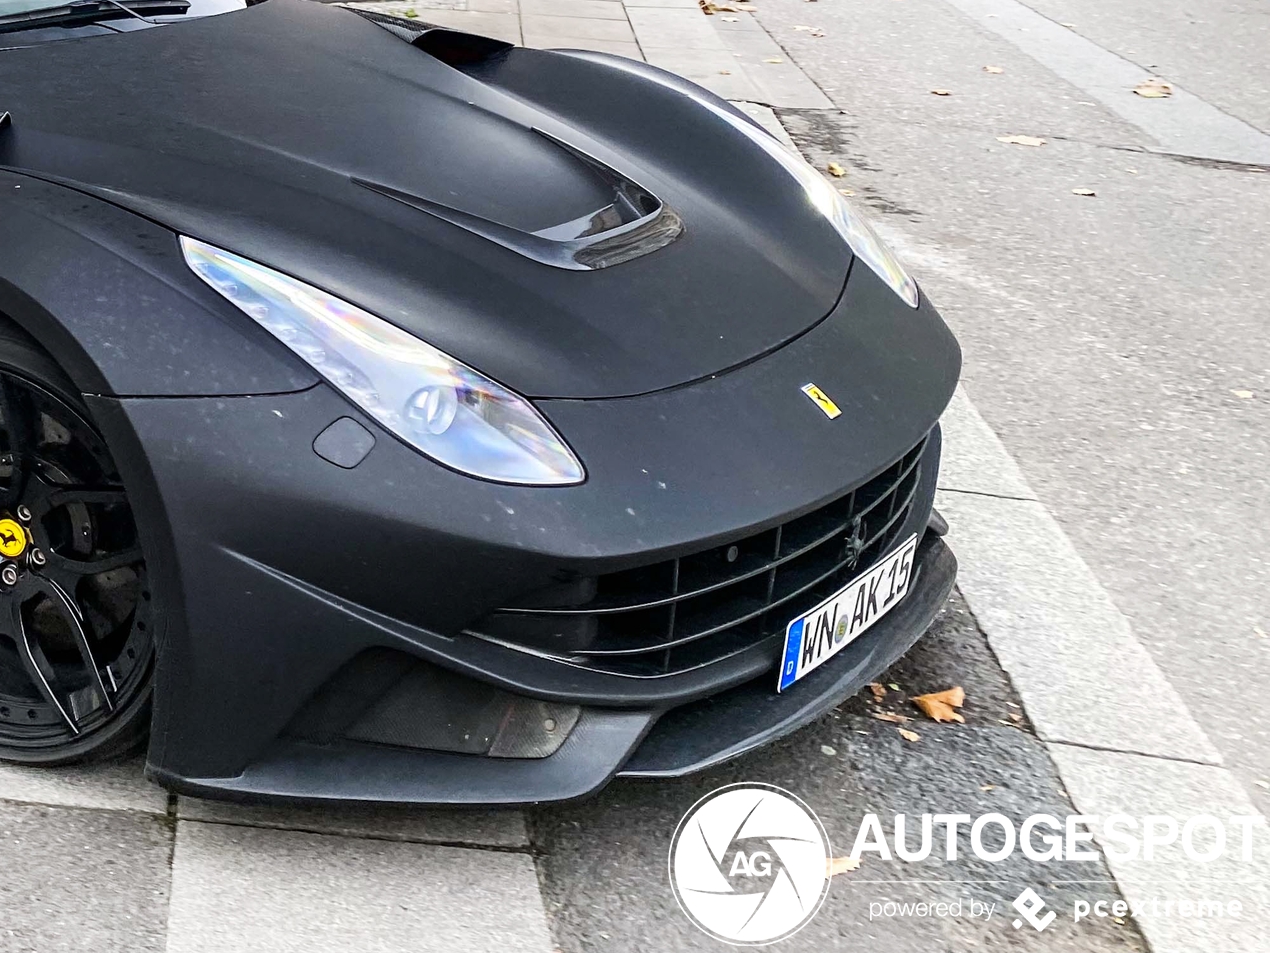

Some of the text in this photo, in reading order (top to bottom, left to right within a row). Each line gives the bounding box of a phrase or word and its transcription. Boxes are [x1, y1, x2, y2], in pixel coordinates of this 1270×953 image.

[802, 545, 914, 669] WN AK 15
